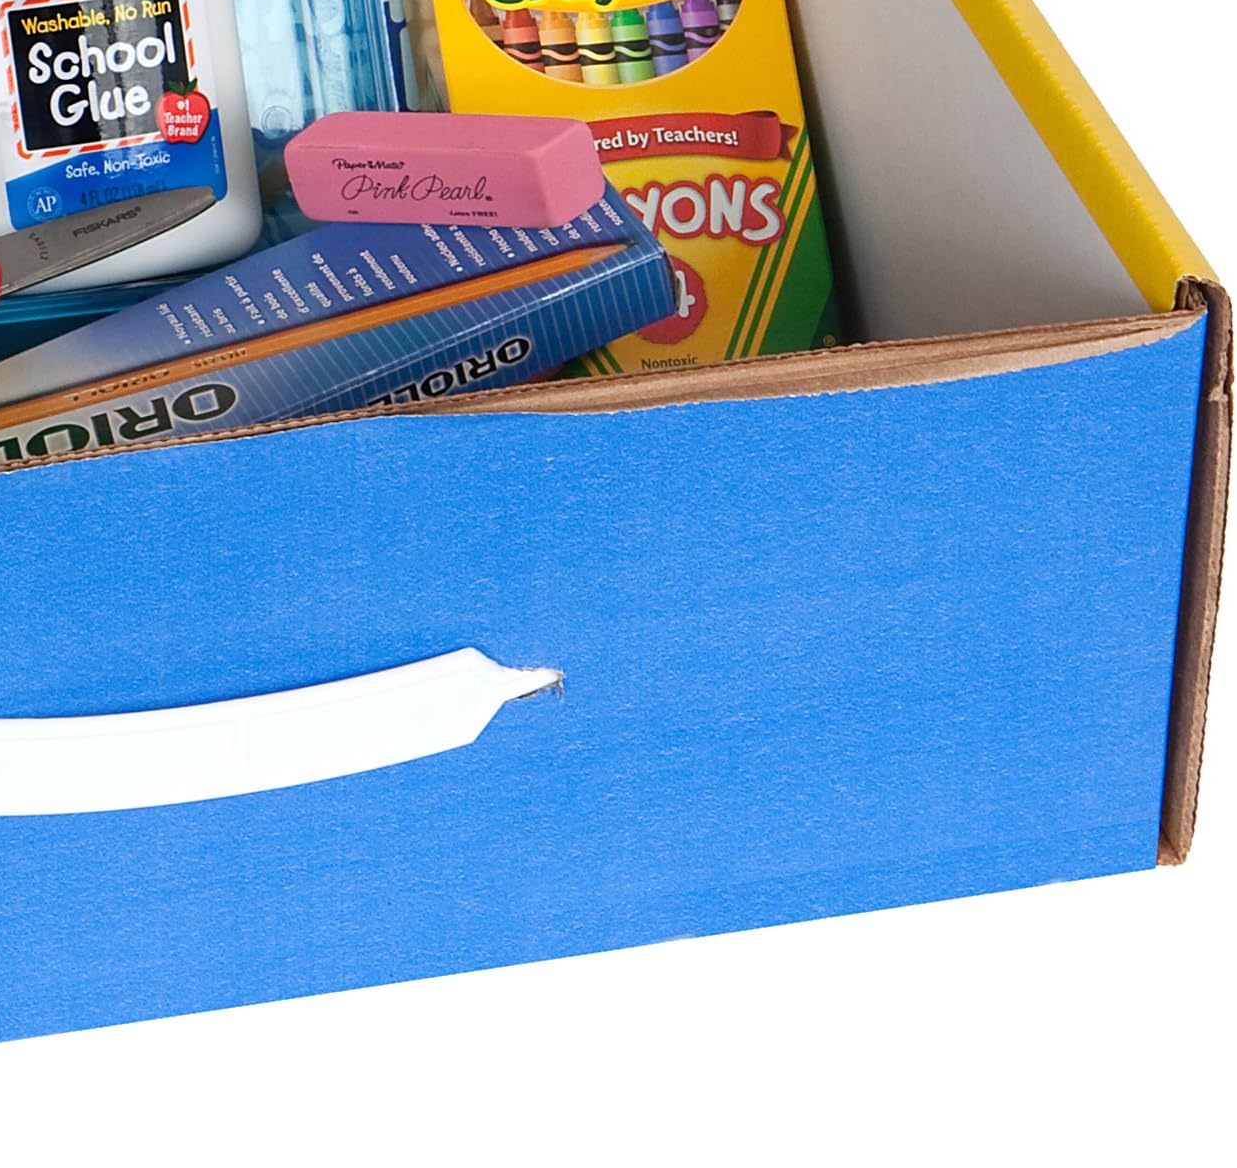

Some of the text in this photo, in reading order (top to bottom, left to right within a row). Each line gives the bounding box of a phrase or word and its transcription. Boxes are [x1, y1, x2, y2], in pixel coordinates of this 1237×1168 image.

[21, 0, 172, 35] Washable, No Run
[28, 21, 176, 85] School
[50, 84, 151, 128] Glue
[164, 111, 203, 124] Teacher
[167, 124, 199, 136] Brand
[627, 130, 649, 149] by
[653, 126, 739, 145] Teachers!
[104, 153, 170, 175] Non-Toxic
[342, 174, 410, 201] Pink
[35, 196, 57, 213] AP
[626, 180, 779, 241] YONS
[73, 210, 139, 238] FISKARS
[319, 264, 355, 302] provenant
[360, 250, 396, 290] rendement
[641, 355, 699, 371] Nontoxic
